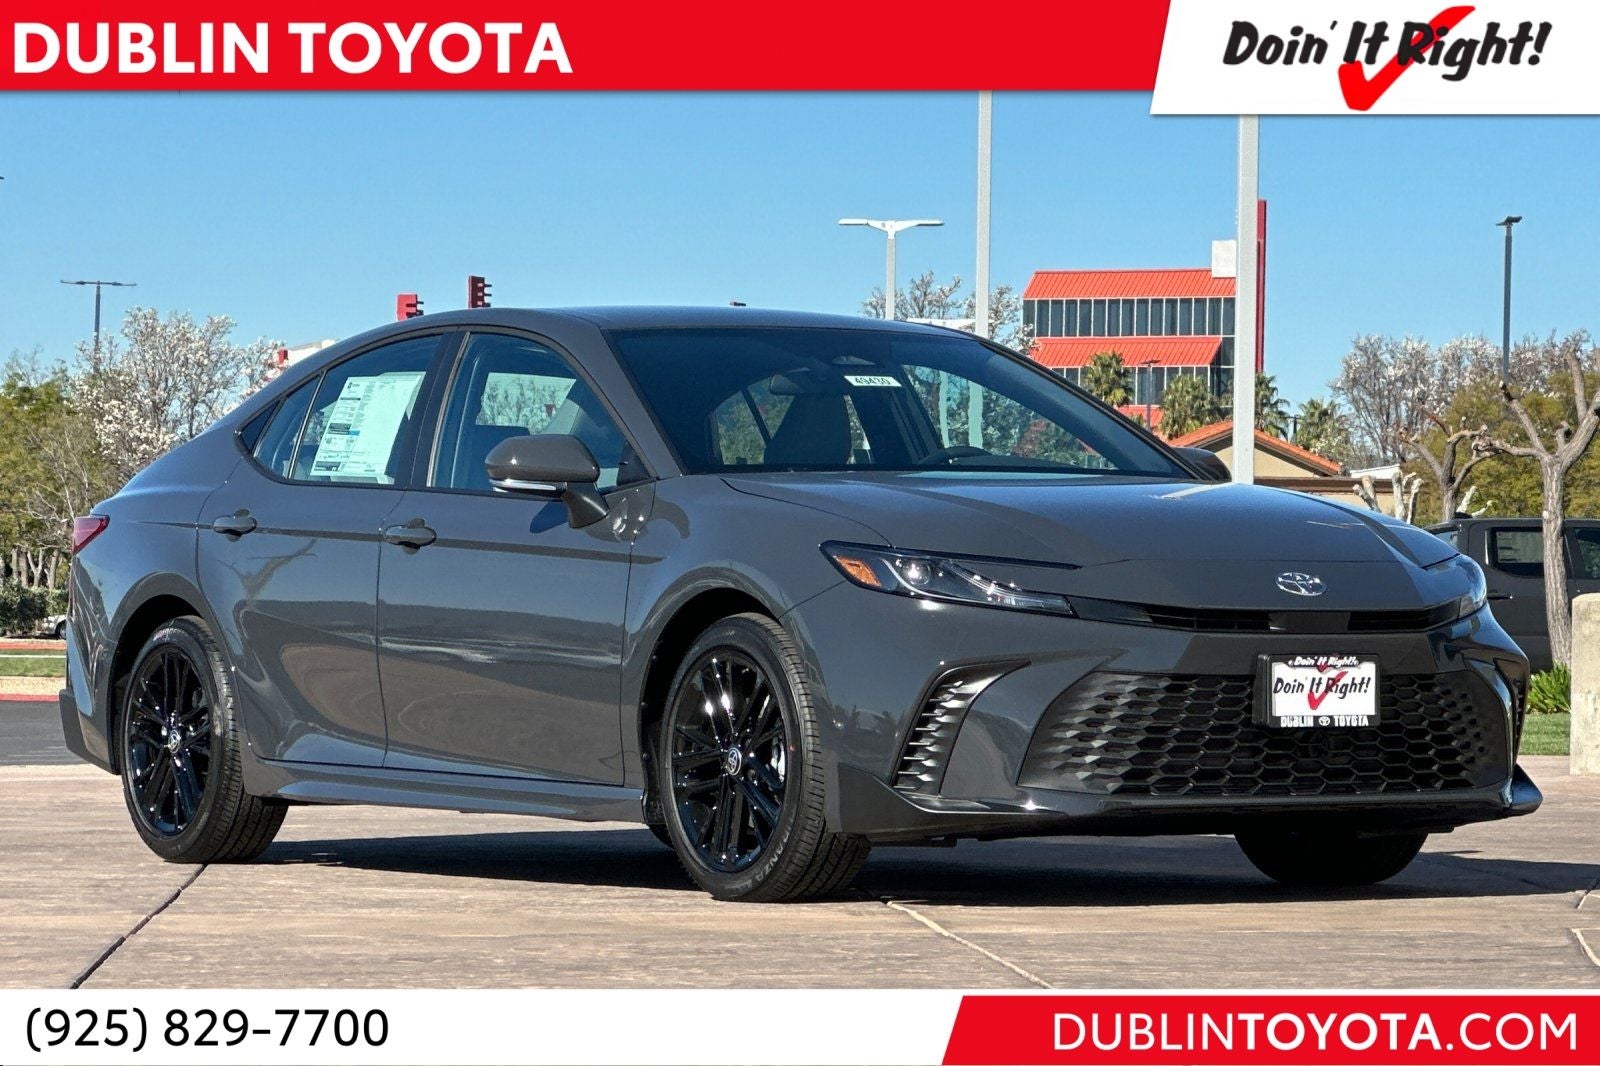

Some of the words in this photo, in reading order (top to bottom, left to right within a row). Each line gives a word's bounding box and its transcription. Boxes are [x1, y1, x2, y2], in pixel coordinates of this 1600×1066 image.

[1317, 656, 1328, 666] It
[1309, 677, 1323, 694] It
[1324, 677, 1372, 700] Right!
[1281, 716, 1314, 728] DUBLIN
[1334, 716, 1369, 727] TOYOTA
